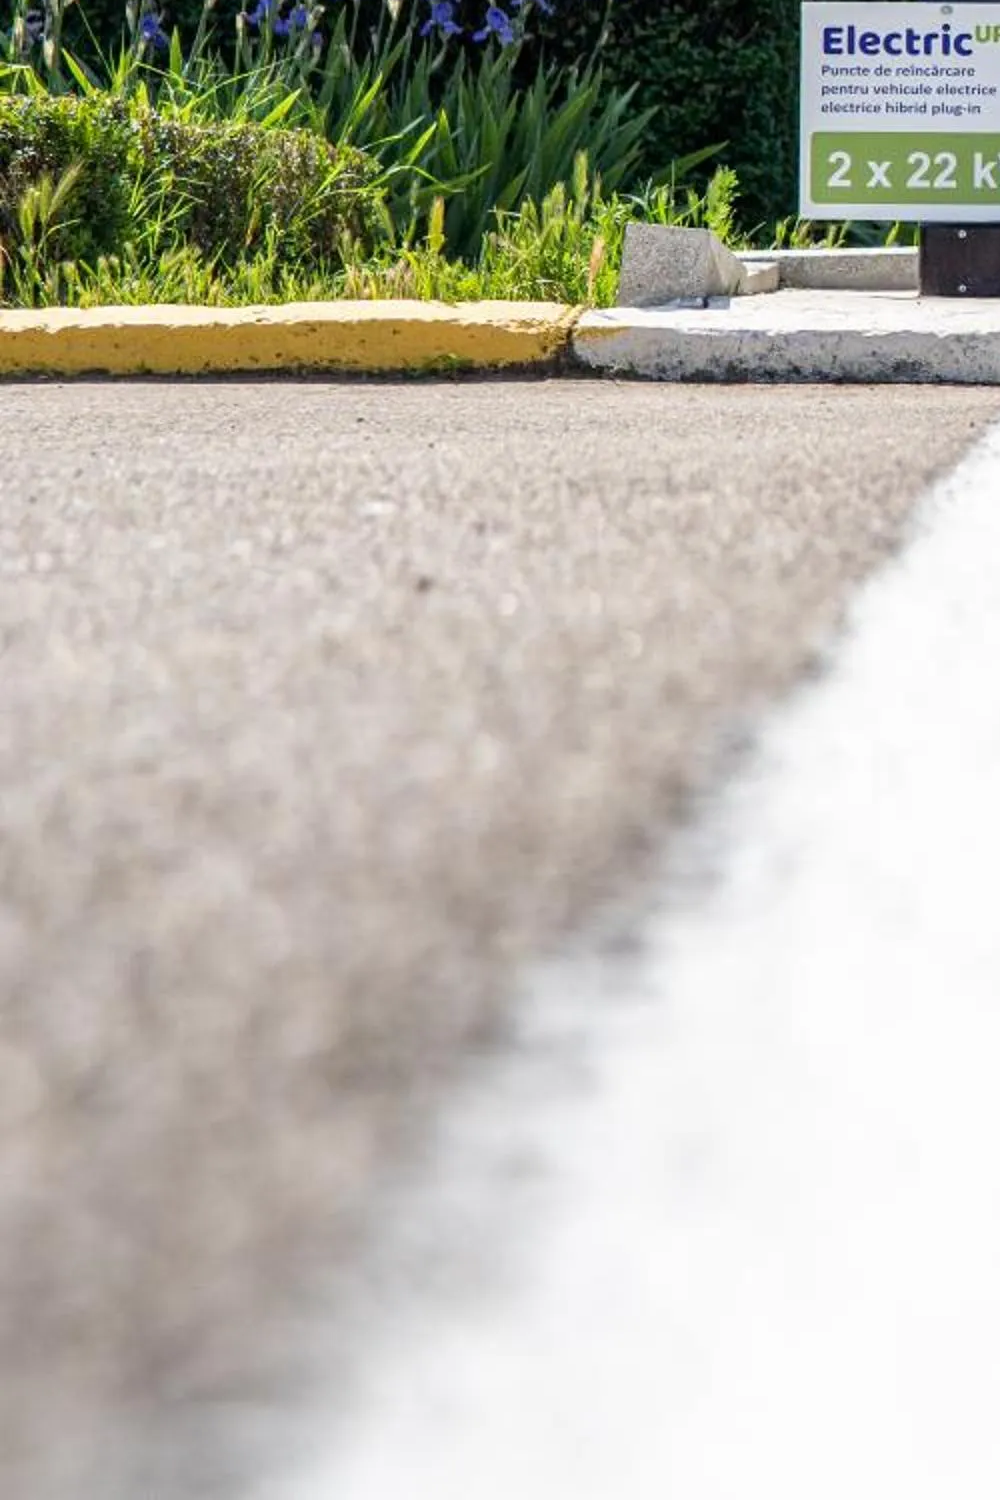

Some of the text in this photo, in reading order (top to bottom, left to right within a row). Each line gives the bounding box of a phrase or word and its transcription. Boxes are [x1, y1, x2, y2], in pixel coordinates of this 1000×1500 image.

[821, 65, 872, 77] Puncte
[874, 65, 893, 77] de
[821, 84, 869, 97] pentru
[873, 83, 933, 96] vehicule
[936, 84, 998, 97] electrice
[821, 102, 982, 116] electrice hibrid plug-in
[827, 151, 853, 188] 2
[866, 160, 893, 188] x
[906, 151, 958, 189] 22
